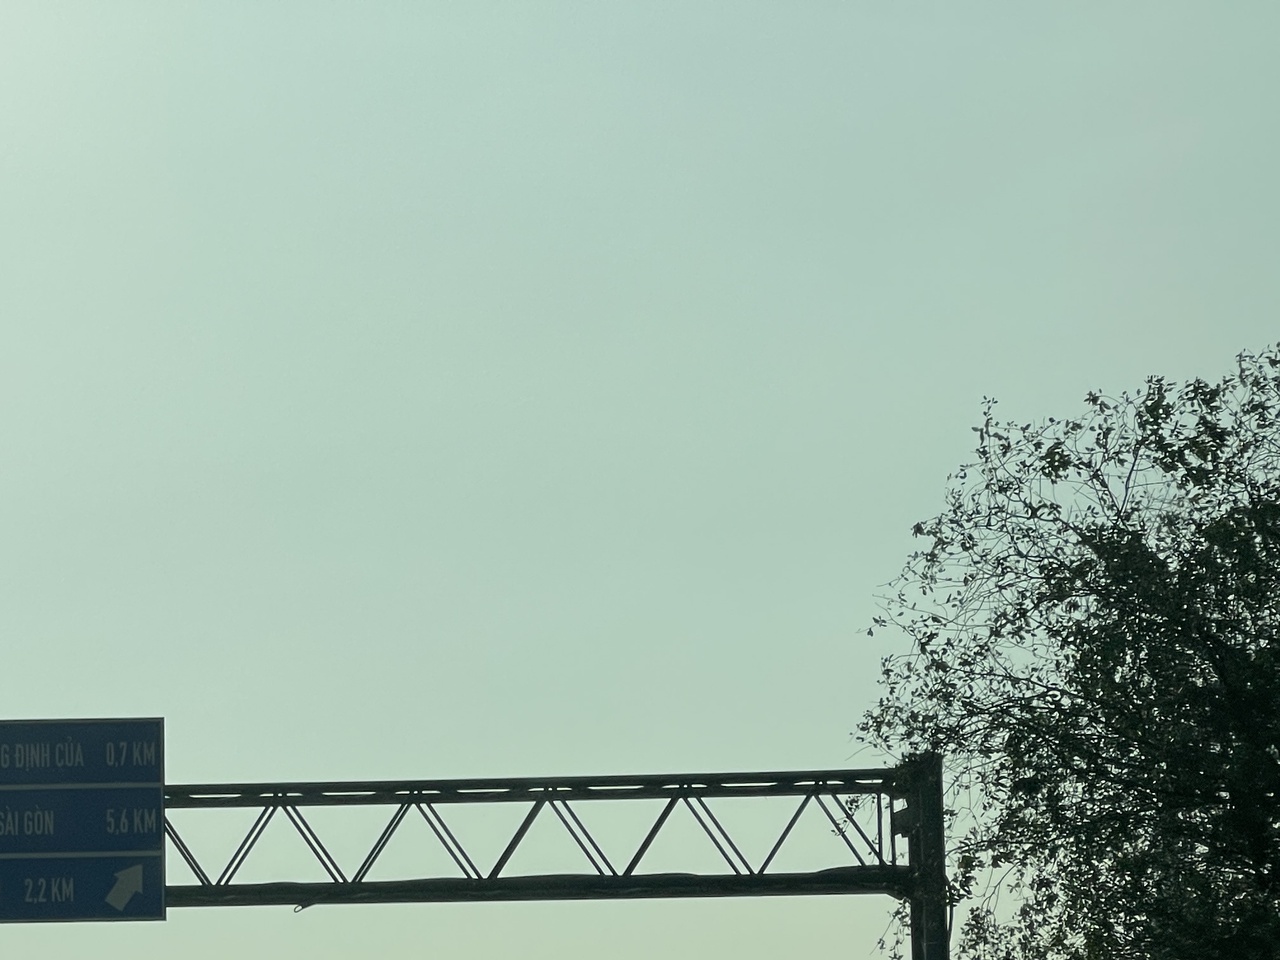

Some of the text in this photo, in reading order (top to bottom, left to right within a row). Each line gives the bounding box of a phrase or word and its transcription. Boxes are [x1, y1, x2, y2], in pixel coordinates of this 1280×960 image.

[14, 742, 50, 773] ĐỊNH
[55, 736, 85, 768] CỦA
[106, 741, 127, 768] 0,7
[132, 741, 156, 767] KM
[24, 803, 55, 835] GÒN
[106, 808, 129, 835] 5,6
[133, 808, 157, 834] KM
[24, 878, 47, 904] 2,2
[51, 878, 74, 903] KM
